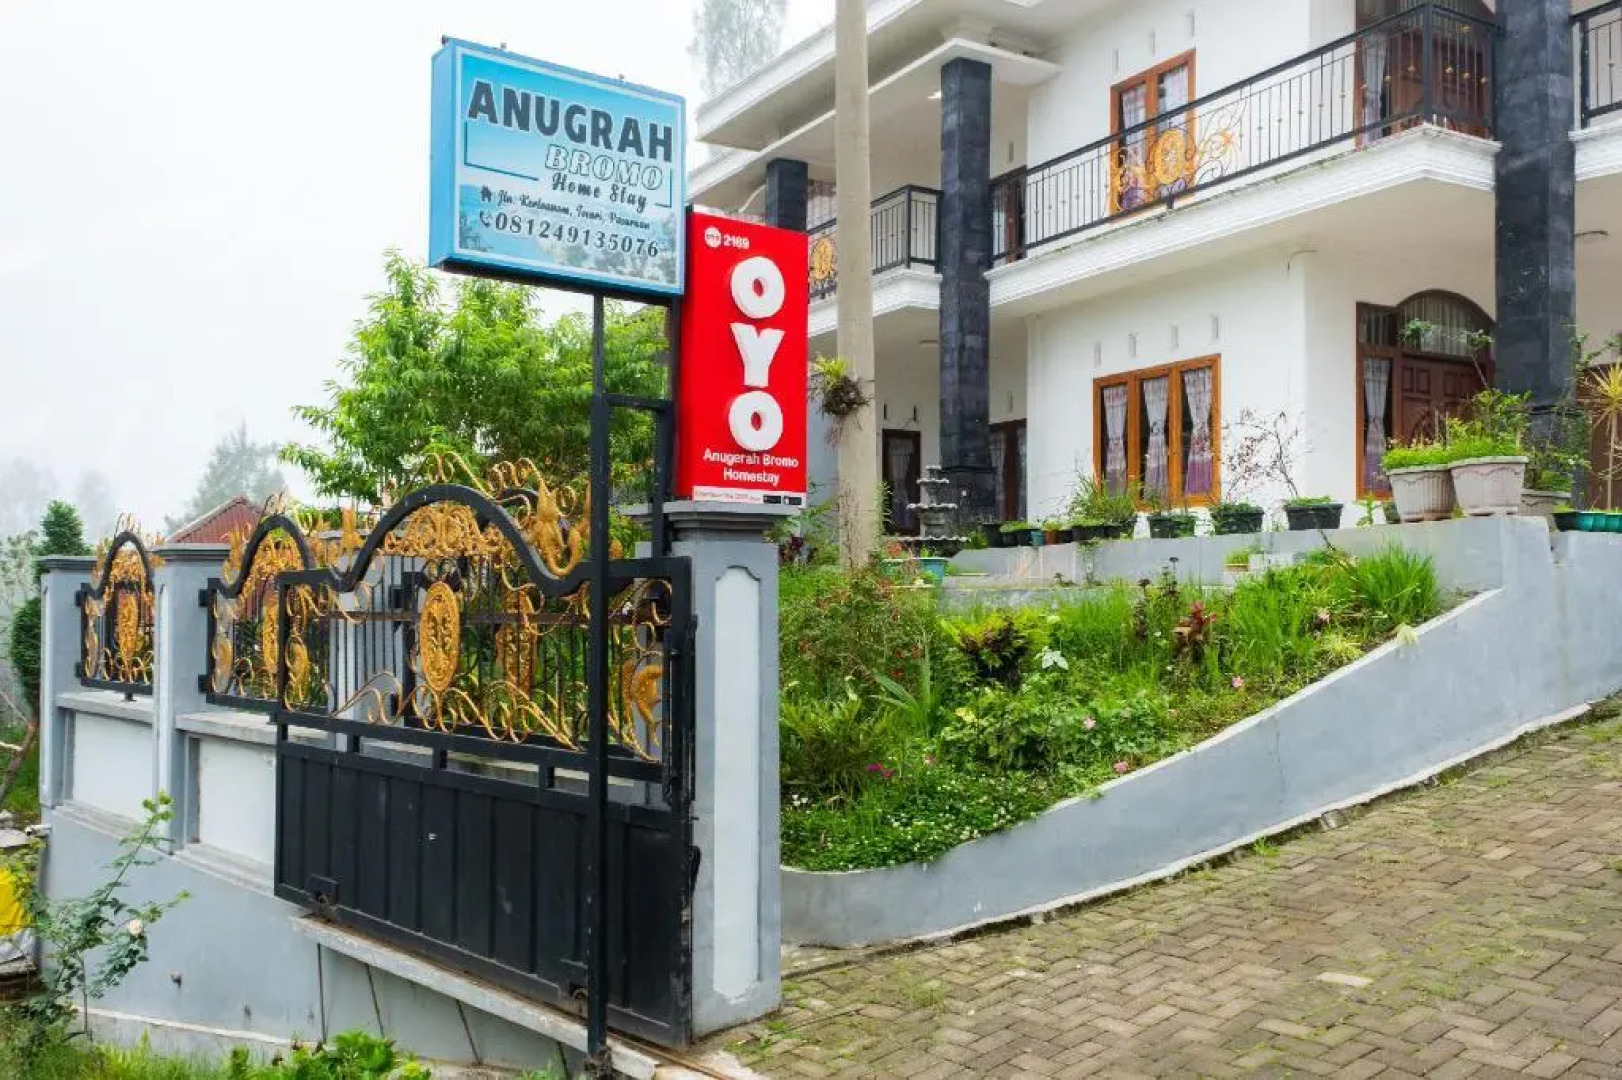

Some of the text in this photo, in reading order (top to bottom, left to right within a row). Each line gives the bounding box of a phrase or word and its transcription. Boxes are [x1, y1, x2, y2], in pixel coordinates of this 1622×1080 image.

[468, 80, 673, 162] ANUGRAH
[545, 144, 663, 190] BROMO
[552, 172, 648, 213] Home Stay
[495, 212, 658, 257] 081249135076
[729, 256, 786, 451] OYO
[703, 448, 799, 468] Anugerah Bromo
[723, 467, 780, 486] Homestay
